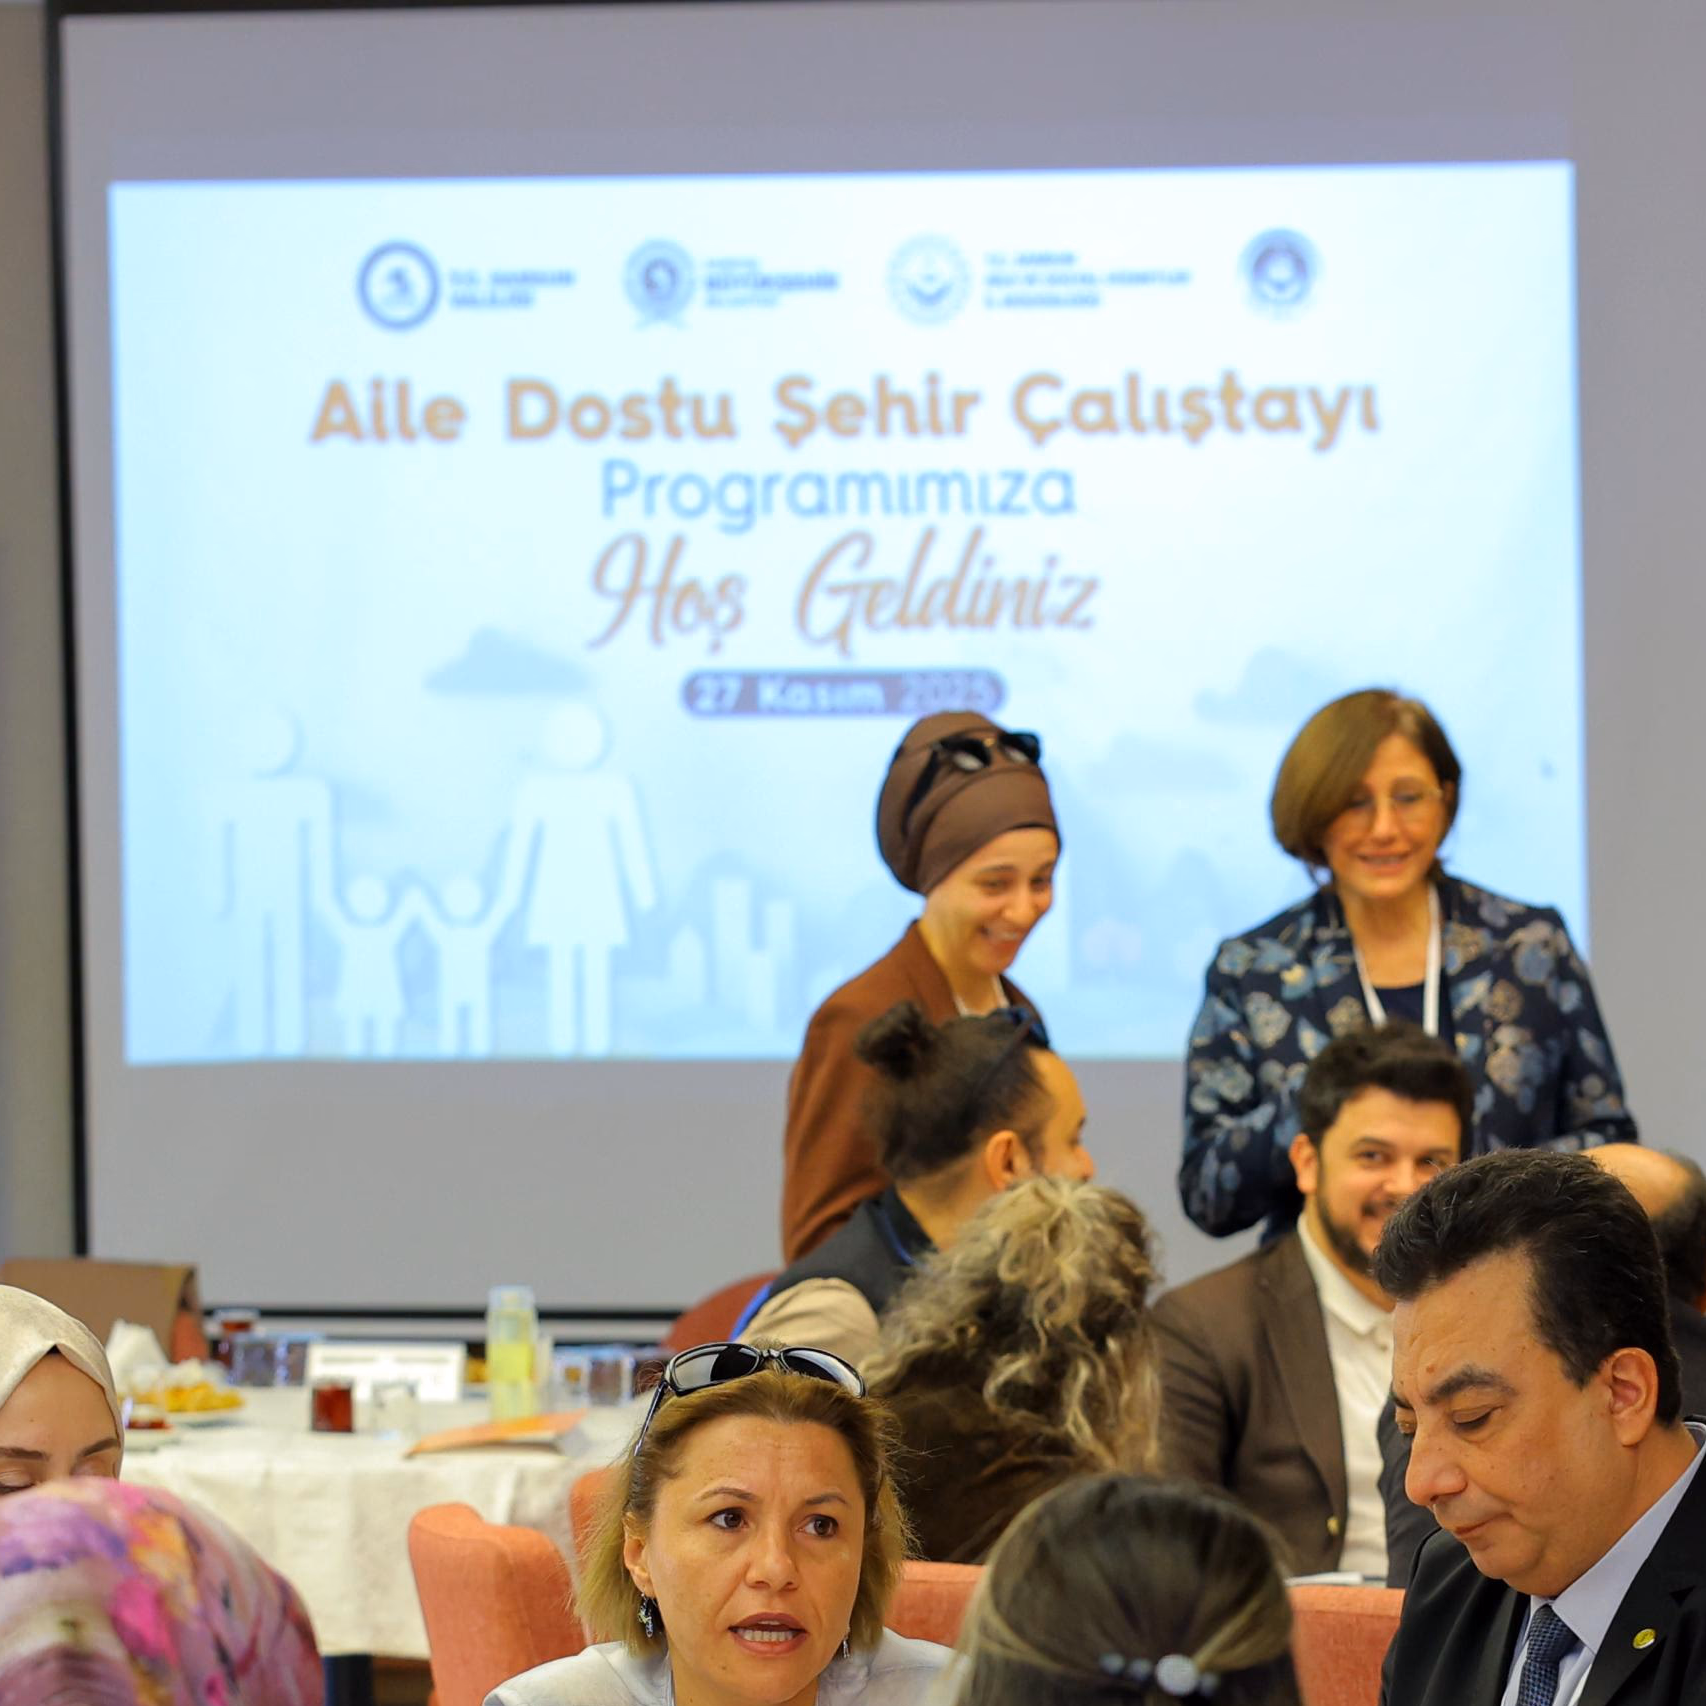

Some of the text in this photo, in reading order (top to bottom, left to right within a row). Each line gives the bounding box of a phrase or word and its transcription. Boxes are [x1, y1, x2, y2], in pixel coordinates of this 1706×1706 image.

[308, 369, 1382, 453] Aile Dostu Şehir Çalıştayı
[601, 458, 1077, 535] Programımıza
[584, 524, 1100, 658] Hoş Geldiniz
[694, 675, 743, 711] 27
[757, 675, 886, 711] Kasım
